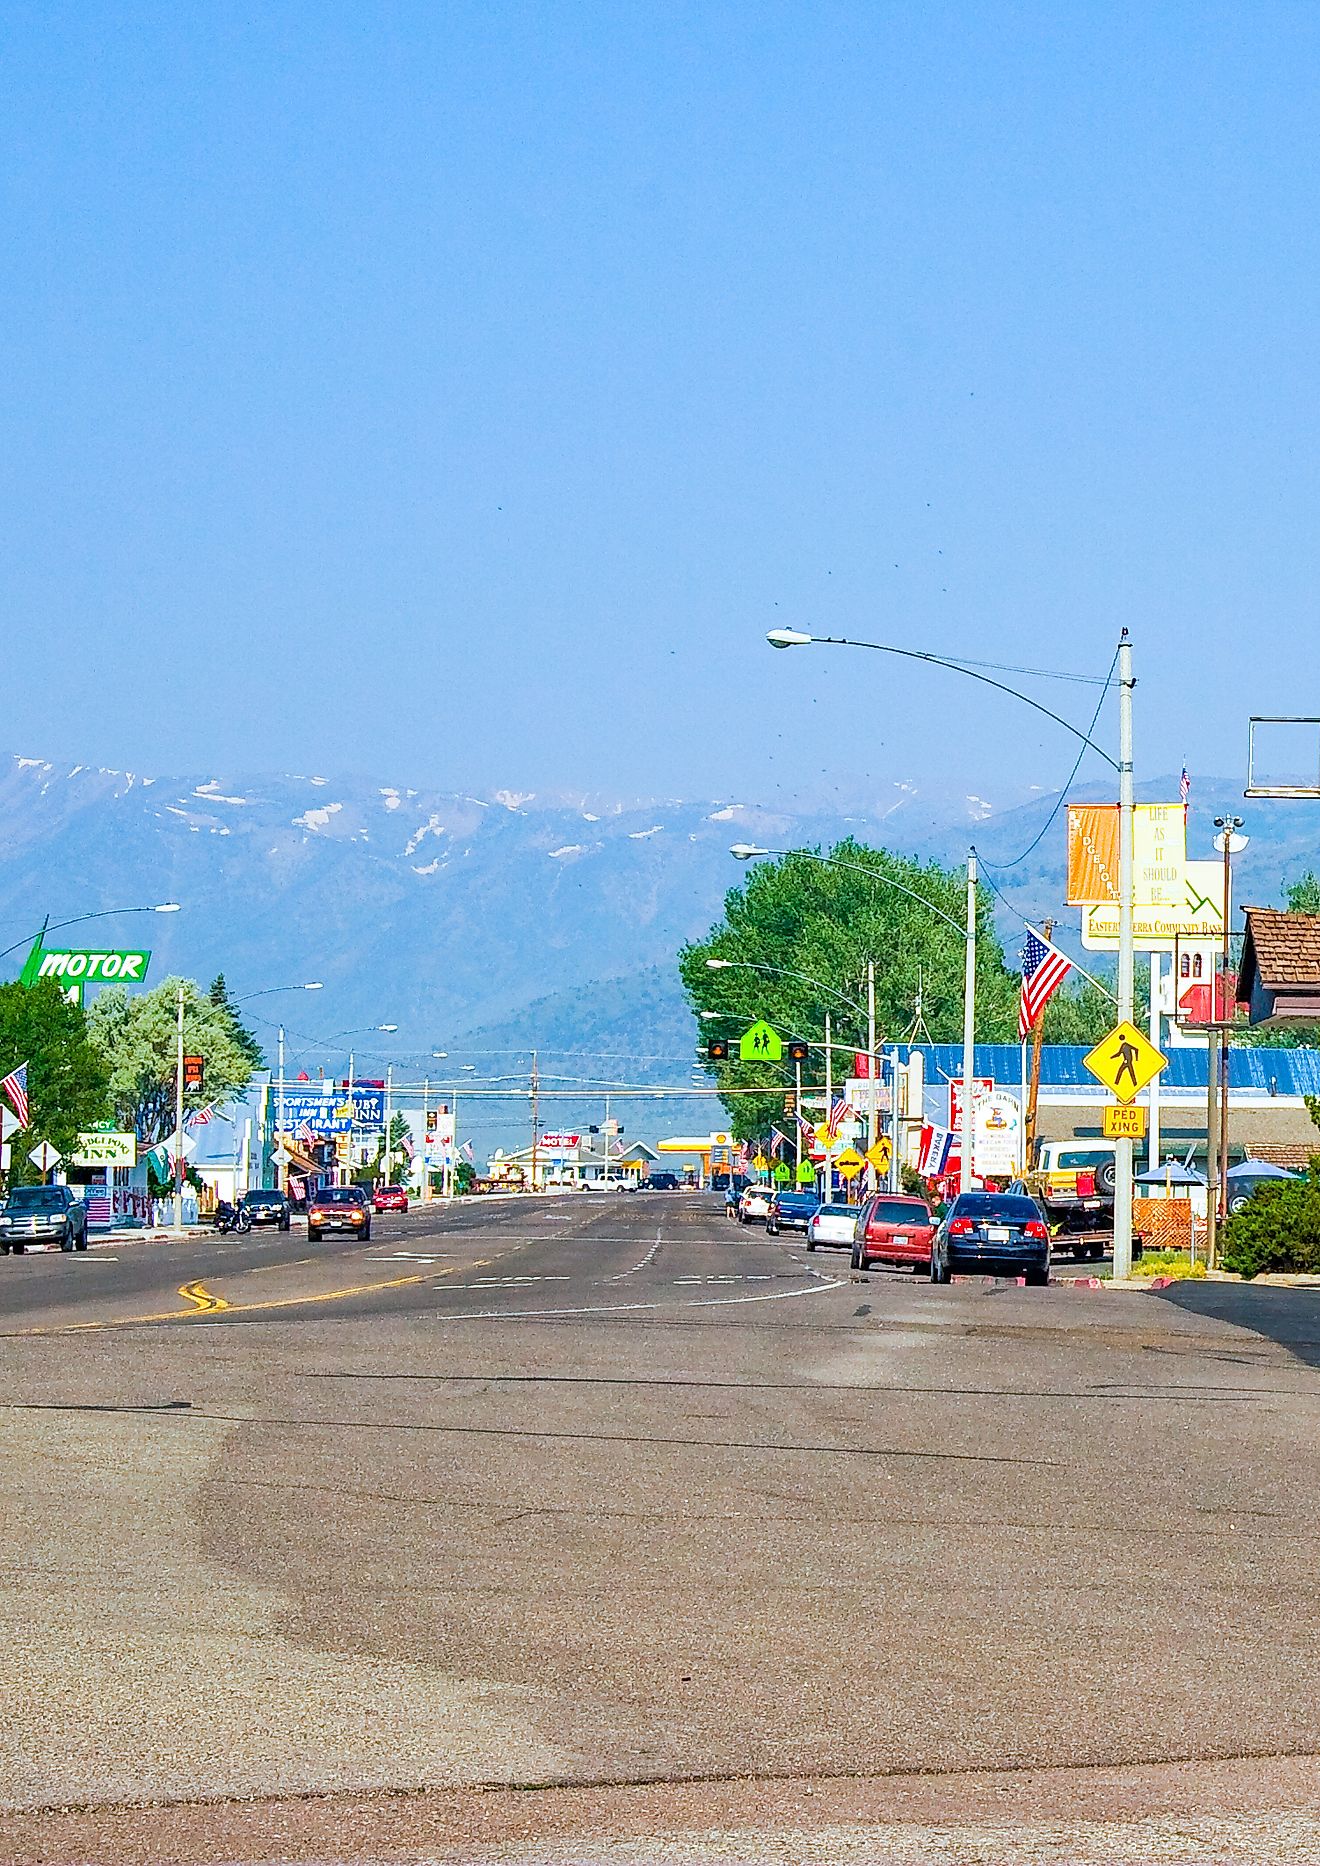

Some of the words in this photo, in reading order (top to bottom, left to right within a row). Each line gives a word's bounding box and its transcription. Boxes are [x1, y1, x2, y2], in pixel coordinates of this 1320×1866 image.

[1150, 807, 1168, 821] LIFE
[1154, 827, 1165, 841] AS
[1069, 810, 1119, 900] BRIDGEPORT
[1155, 847, 1164, 861] IT
[1143, 867, 1177, 881] SHOULD
[38, 953, 143, 978] MOTOR
[354, 1110, 381, 1120] INN
[1113, 1109, 1137, 1120] PED
[1110, 1121, 1139, 1132] XING
[542, 1137, 576, 1146] MOTEL
[83, 1149, 117, 1159] INN
